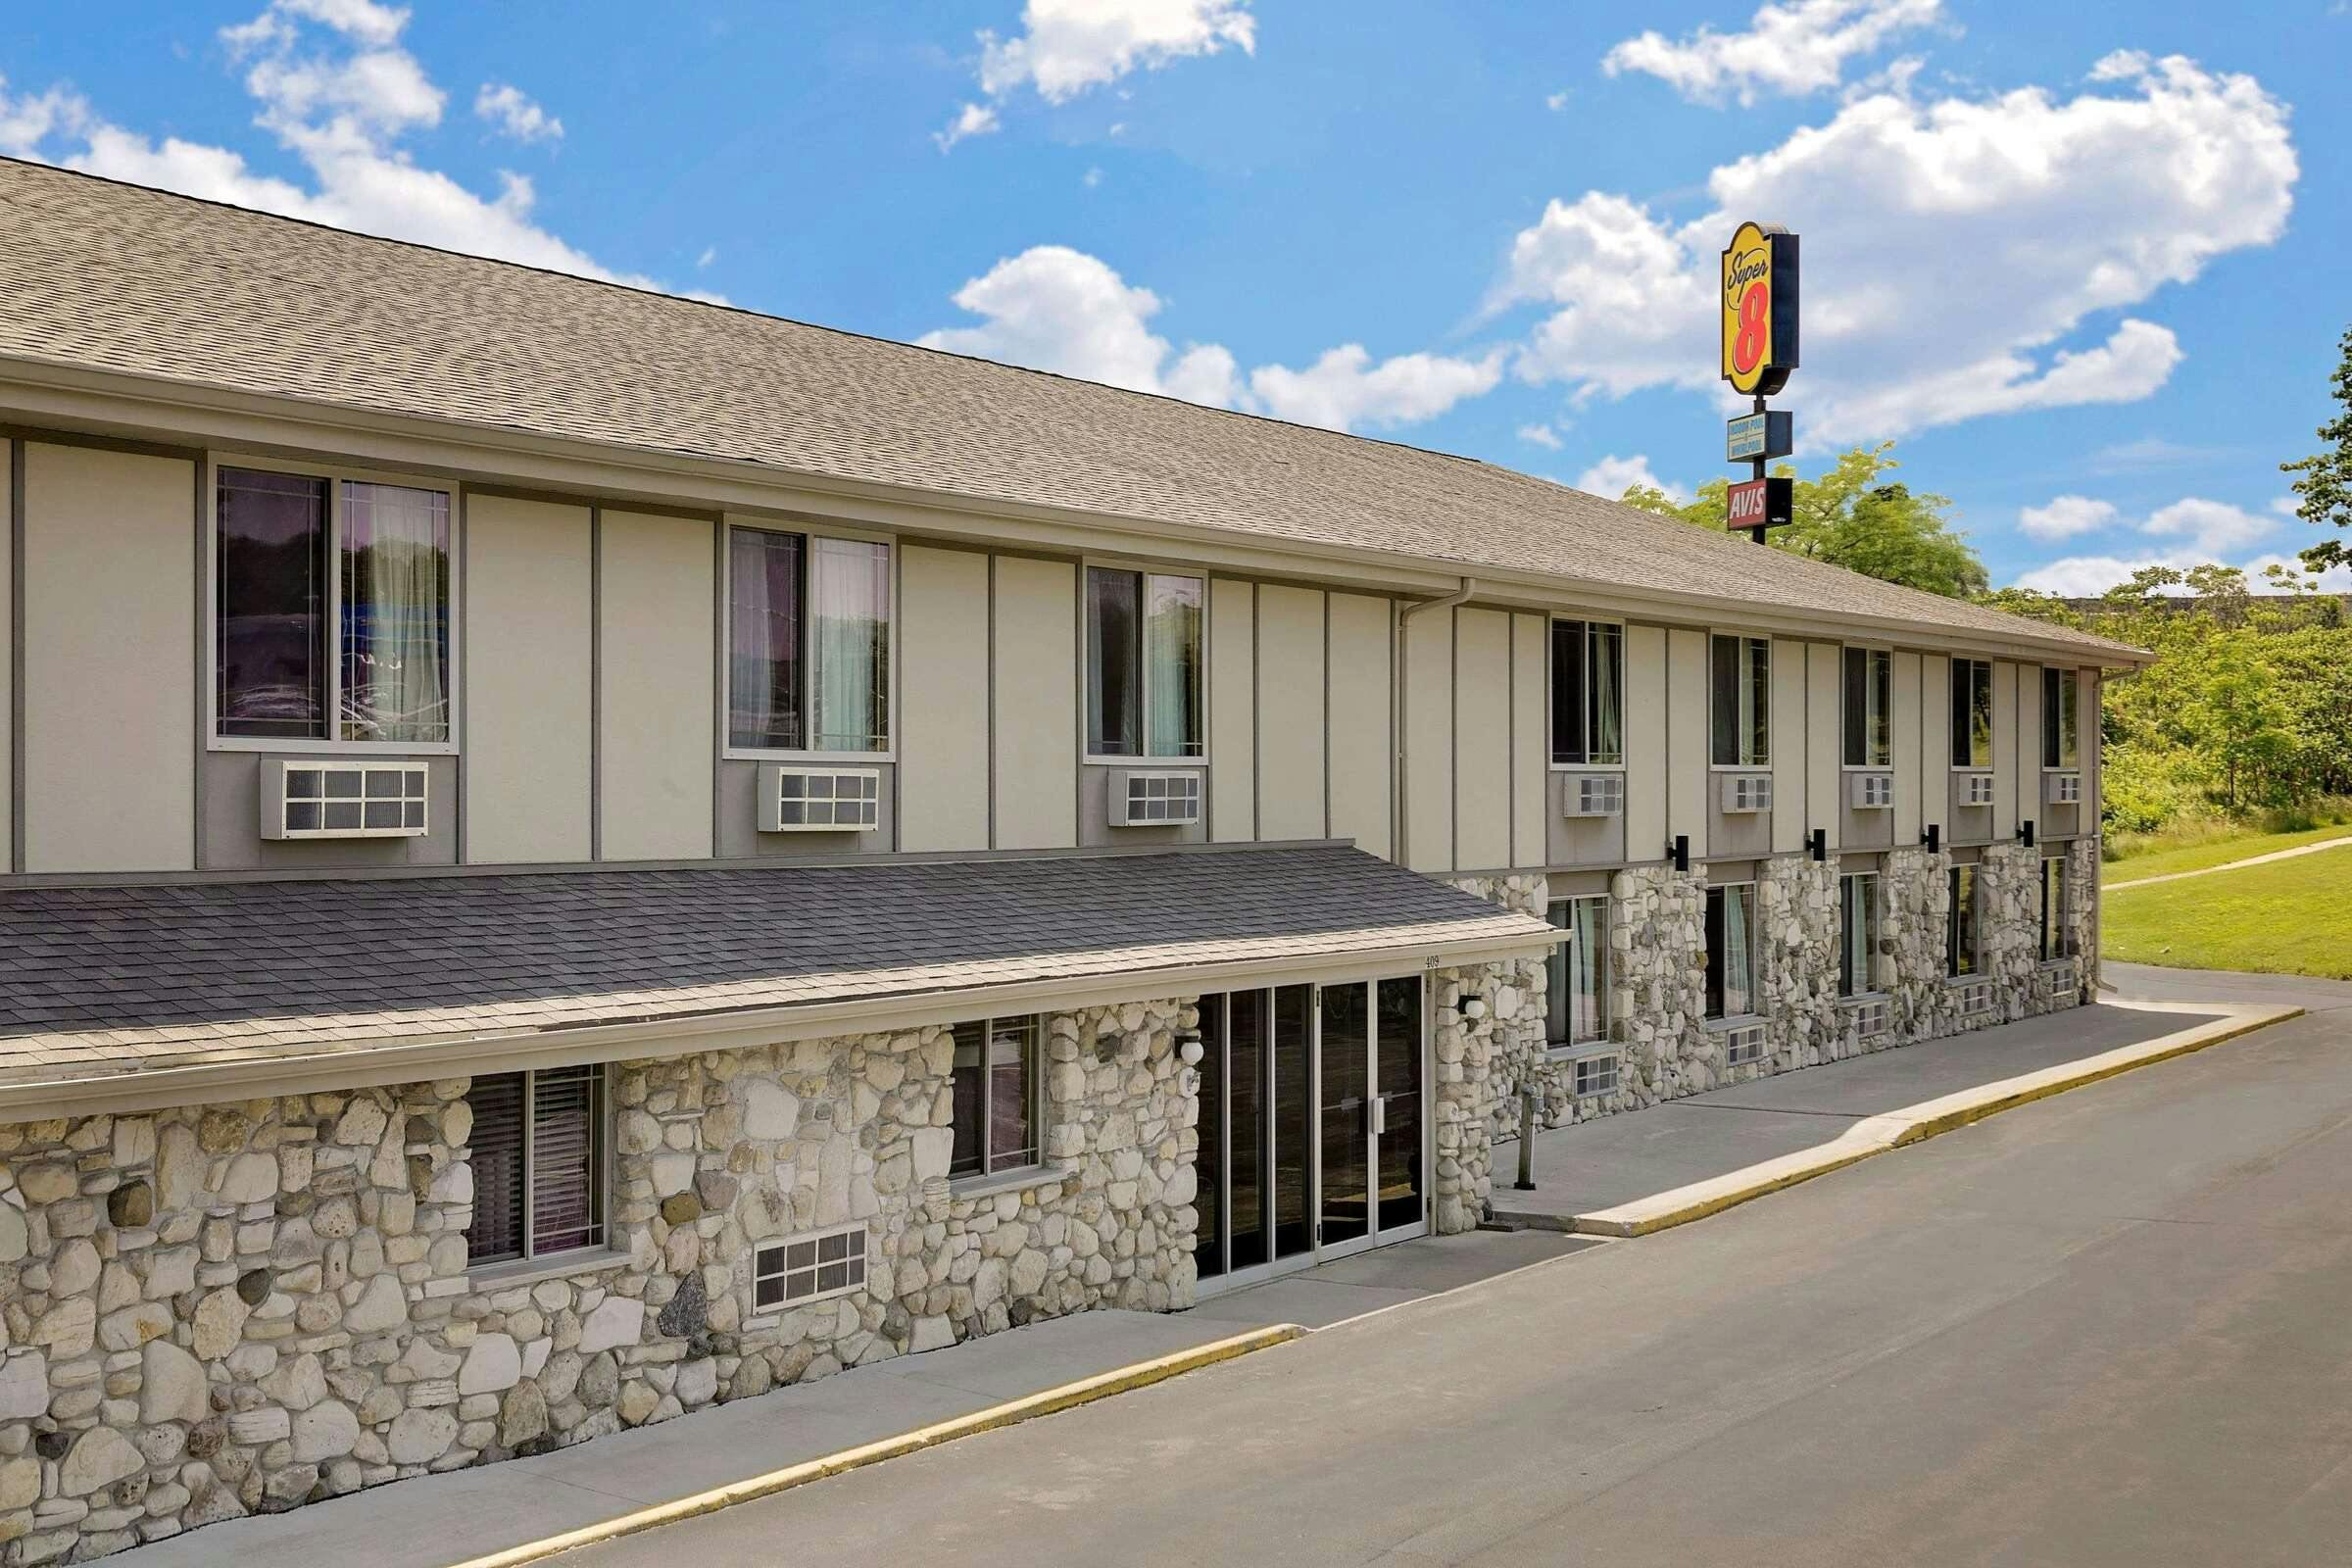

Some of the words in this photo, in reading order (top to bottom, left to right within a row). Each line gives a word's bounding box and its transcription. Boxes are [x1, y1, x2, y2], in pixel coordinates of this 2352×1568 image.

[1727, 248, 1768, 306] Super
[1733, 282, 1768, 375] 8
[1729, 486, 1765, 519] AVIS
[1425, 955, 1440, 968] 409
